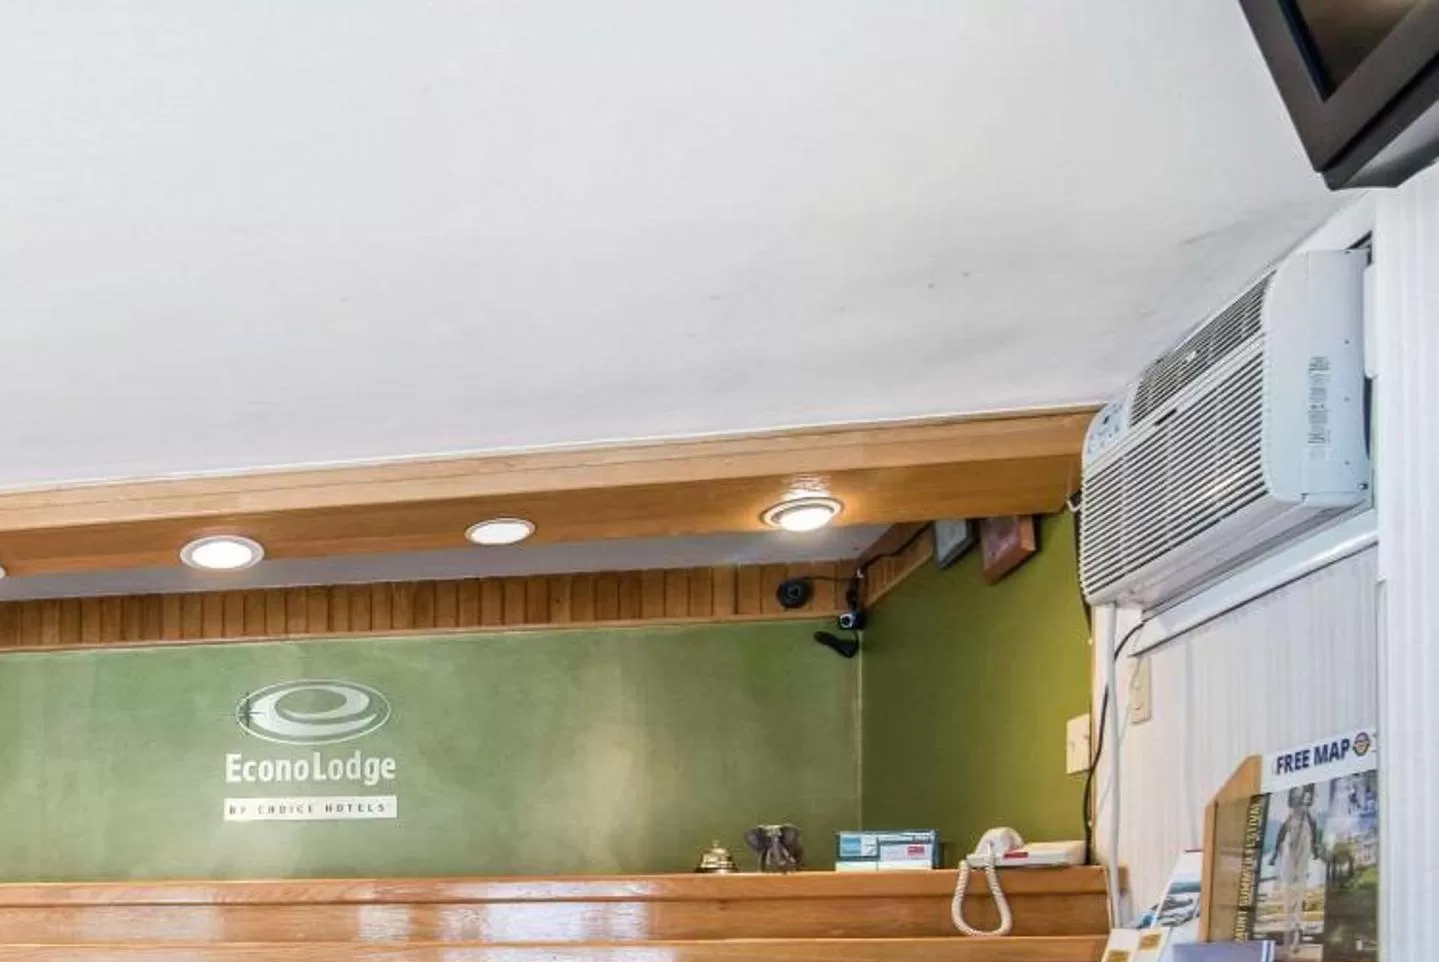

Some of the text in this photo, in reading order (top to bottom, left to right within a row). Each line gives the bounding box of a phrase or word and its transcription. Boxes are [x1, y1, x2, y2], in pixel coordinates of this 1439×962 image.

[225, 750, 396, 786] EconoLodge
[1276, 738, 1350, 775] FREE MAP
[258, 803, 313, 815] CHOICE
[325, 802, 385, 813] HOTELS
